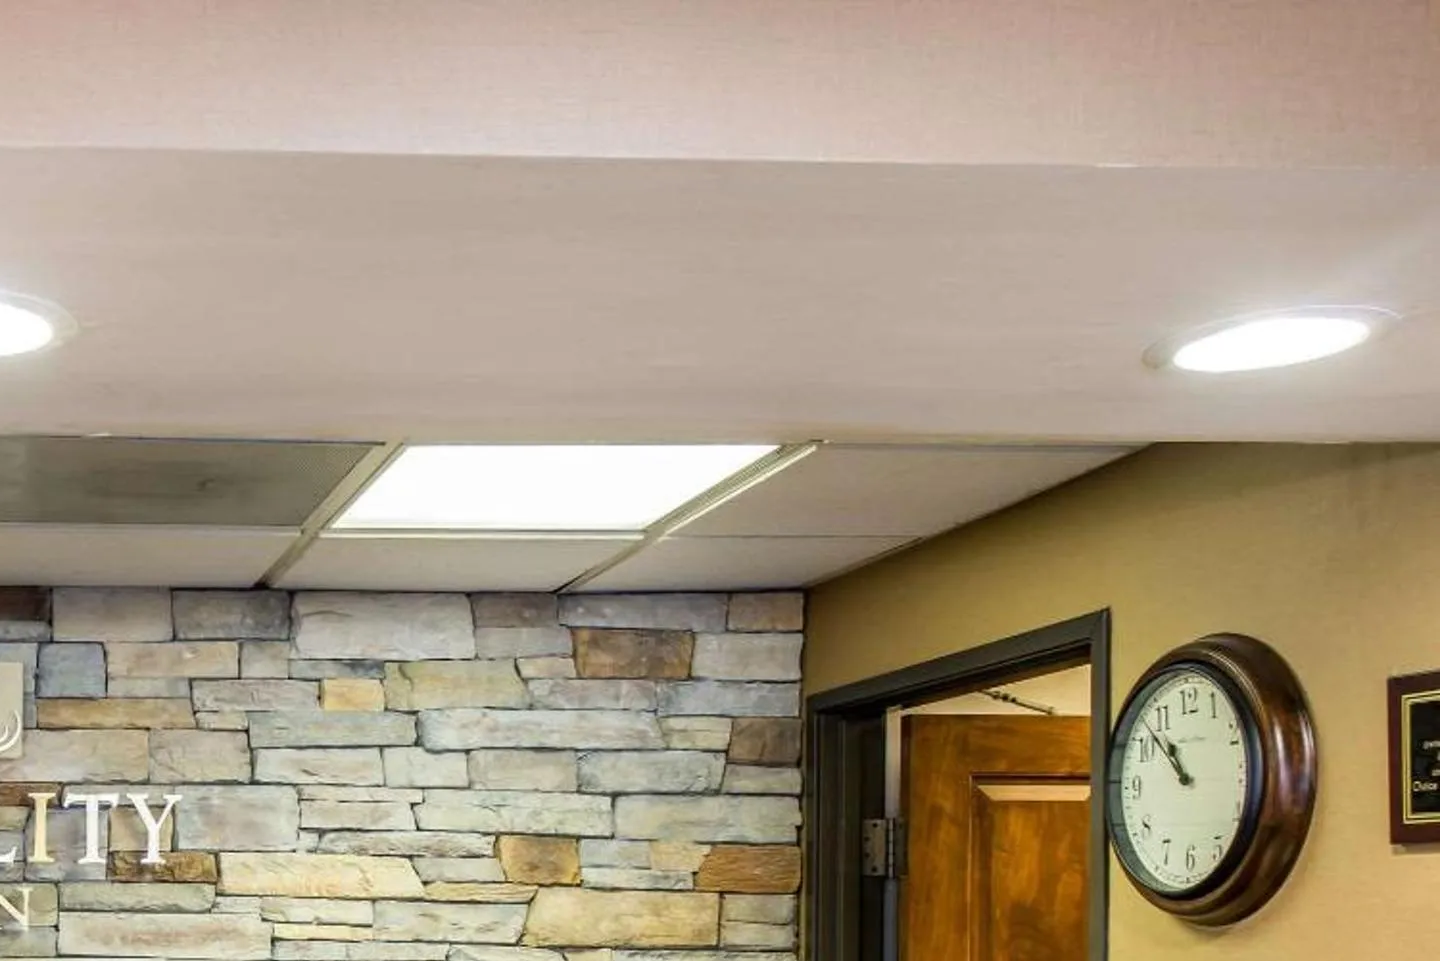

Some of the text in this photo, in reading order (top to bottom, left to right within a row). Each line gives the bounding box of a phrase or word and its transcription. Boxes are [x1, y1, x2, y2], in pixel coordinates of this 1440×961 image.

[1179, 687, 1198, 715] 12
[1208, 691, 1217, 719] 1
[1156, 705, 1170, 732] 11
[1136, 736, 1157, 763] 10
[1162, 838, 1172, 866] 7
[1185, 844, 1196, 871] 6
